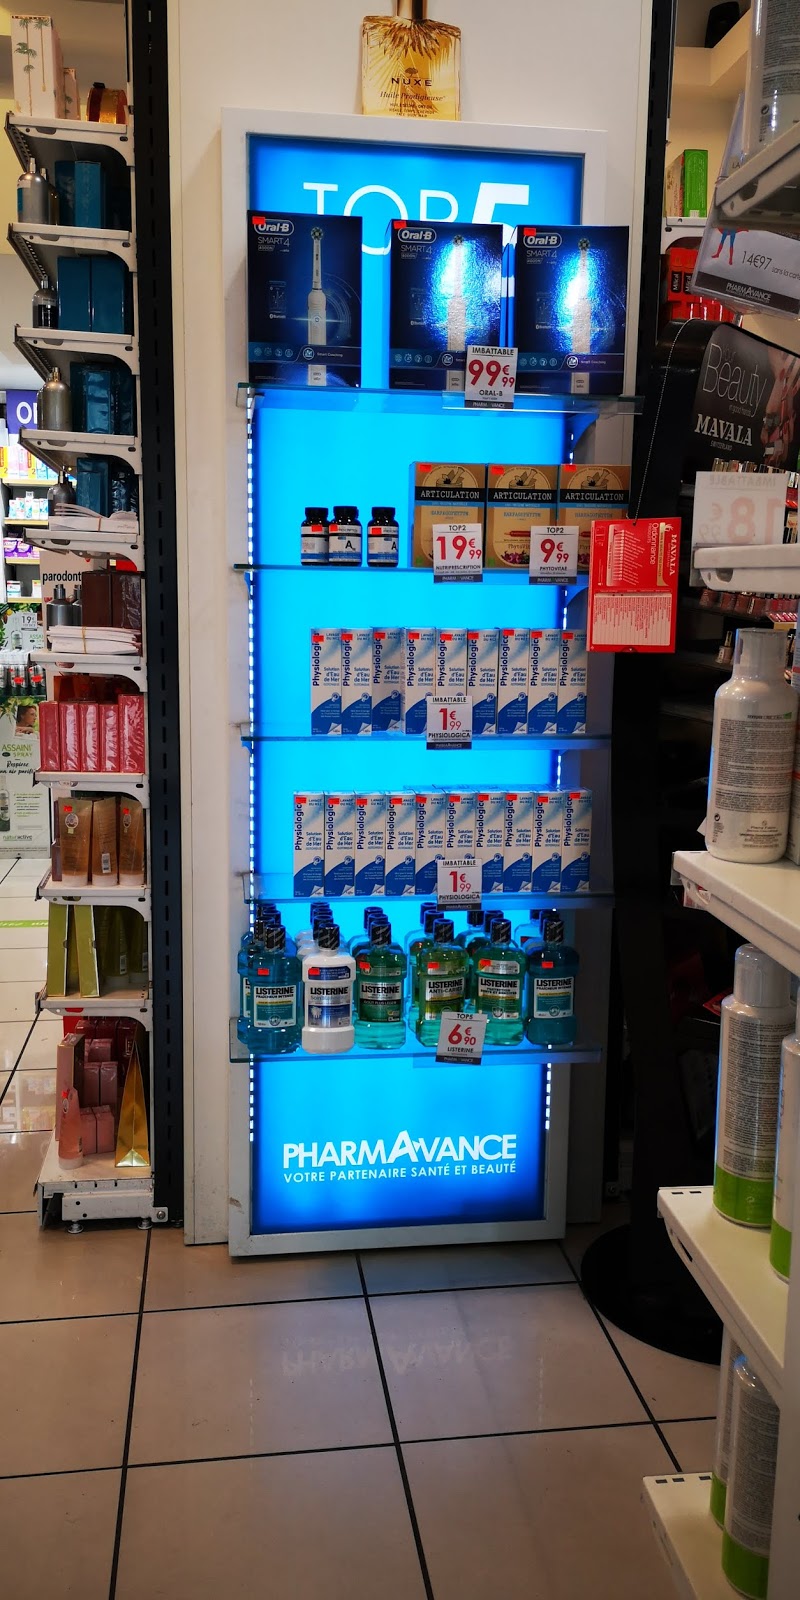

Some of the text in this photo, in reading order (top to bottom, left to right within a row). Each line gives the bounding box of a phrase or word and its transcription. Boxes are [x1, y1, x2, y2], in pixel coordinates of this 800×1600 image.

[392, 78, 432, 86] NUXE
[400, 92, 444, 102] Prodigieuse
[258, 222, 290, 232] Oral-B
[401, 230, 432, 240] Oral-B
[527, 236, 558, 245] Oral-B
[742, 250, 772, 270] 14€97
[726, 282, 772, 300] PHARMAVANCE
[472, 347, 514, 355] IMBATTABLE
[703, 343, 767, 418] Beauty
[694, 414, 752, 446] MAVALA
[421, 490, 480, 499] ARTICULATION
[493, 492, 552, 500] ARTICULATION
[650, 523, 659, 564] Ordonnance
[43, 570, 82, 585] parodont
[343, 640, 352, 686] Physiologic
[373, 638, 382, 683] Physiologic
[407, 639, 416, 686] Physiologic
[438, 640, 447, 686] Physiologic
[469, 640, 478, 687] Physiologic
[530, 638, 540, 686] Physiologic
[560, 639, 569, 686] Physiologic
[295, 804, 304, 850] Physiologic
[326, 804, 335, 850] Physiologic
[357, 805, 366, 850] Physiologic
[387, 802, 396, 850] Physiologic
[417, 803, 426, 849] Physiologic
[447, 803, 456, 848] Physiologic
[476, 800, 485, 847] Physiologic
[505, 800, 515, 847] Physiologic
[535, 802, 544, 847] Physiologic
[256, 986, 294, 994] LISTERINE
[362, 985, 399, 994] LISTERINE
[428, 979, 463, 988] LISTERINE
[480, 979, 517, 988] LISTERINE
[537, 978, 572, 986] LISTERINE
[283, 1130, 516, 1169] PHARMAVANCE
[283, 1161, 516, 1183] VOTRE PARTENAIRE SANTÉ ET BEAUTÉ
